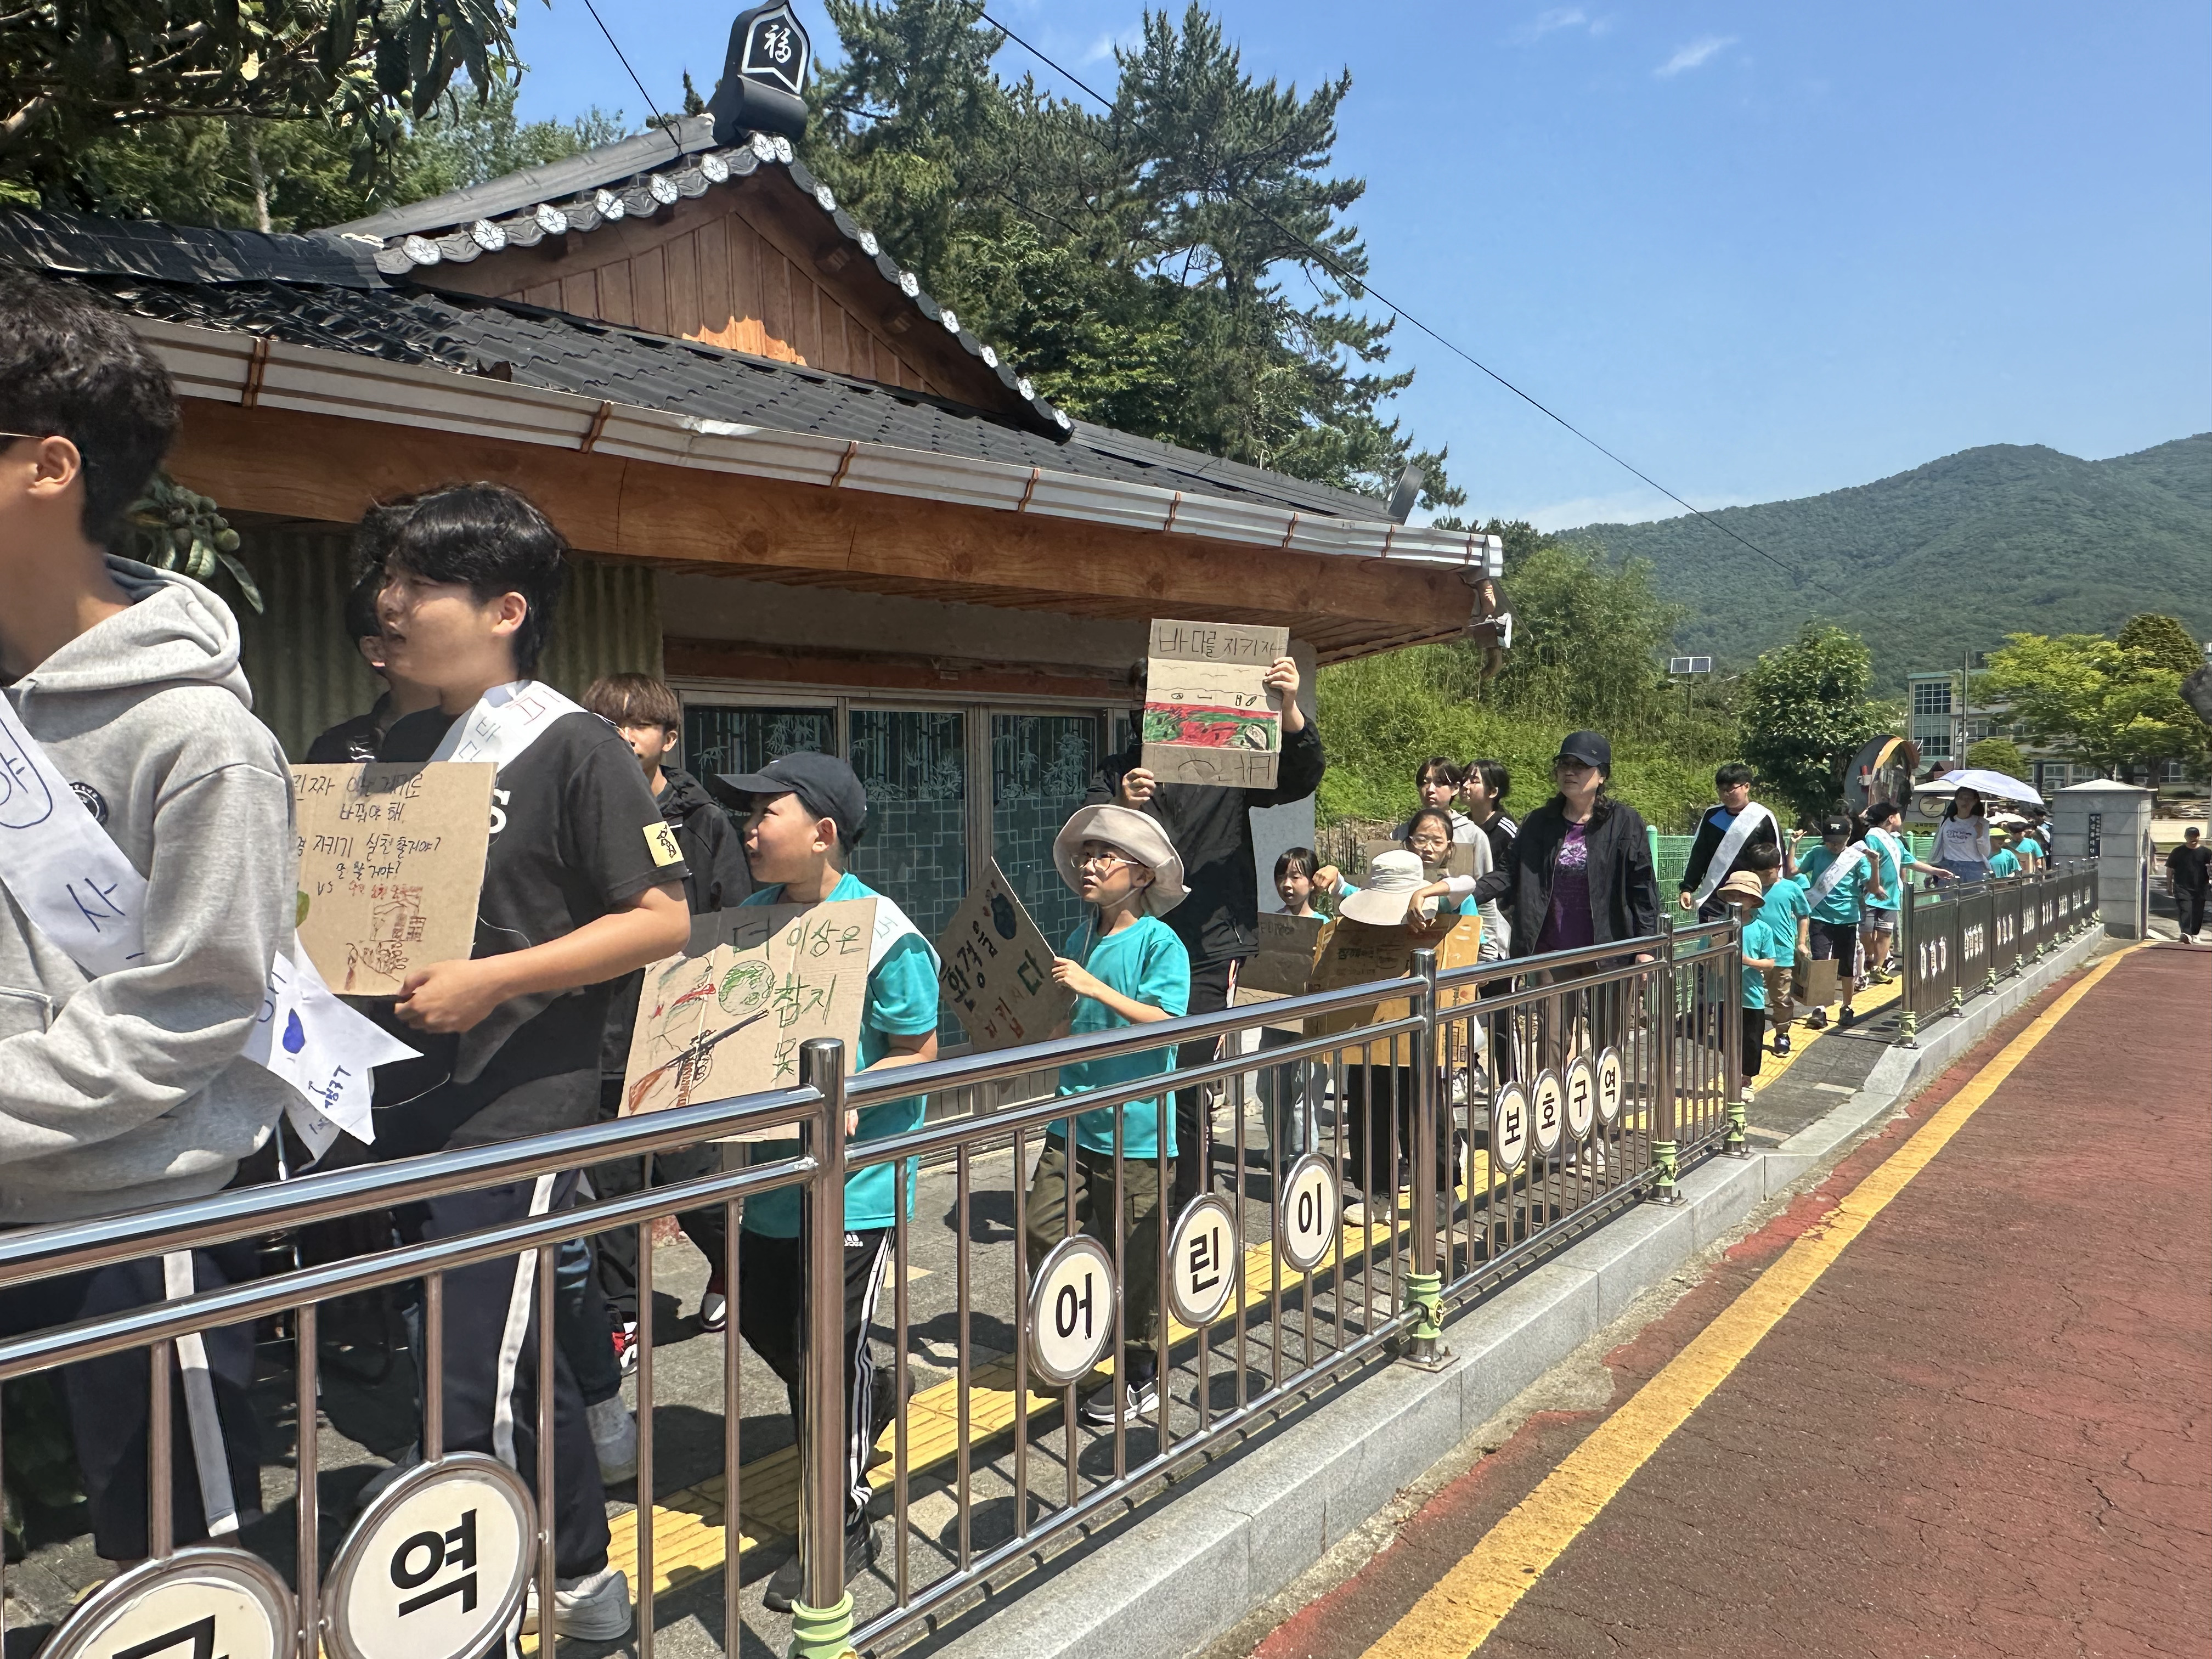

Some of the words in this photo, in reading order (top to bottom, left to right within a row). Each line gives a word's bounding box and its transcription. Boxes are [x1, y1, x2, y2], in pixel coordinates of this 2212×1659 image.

[764, 24, 792, 64] 福
[732, 918, 770, 960] 더
[786, 917, 863, 957] 이상은
[771, 973, 837, 1028] 참지
[1504, 1107, 1521, 1147] 보
[1541, 1092, 1556, 1130] 호
[1573, 1079, 1587, 1118] 구
[1605, 1066, 1616, 1103] 역
[1056, 1272, 1093, 1340] 어
[1189, 1226, 1220, 1295] 린
[1297, 1182, 1322, 1236] 이
[390, 1508, 477, 1618] 역
